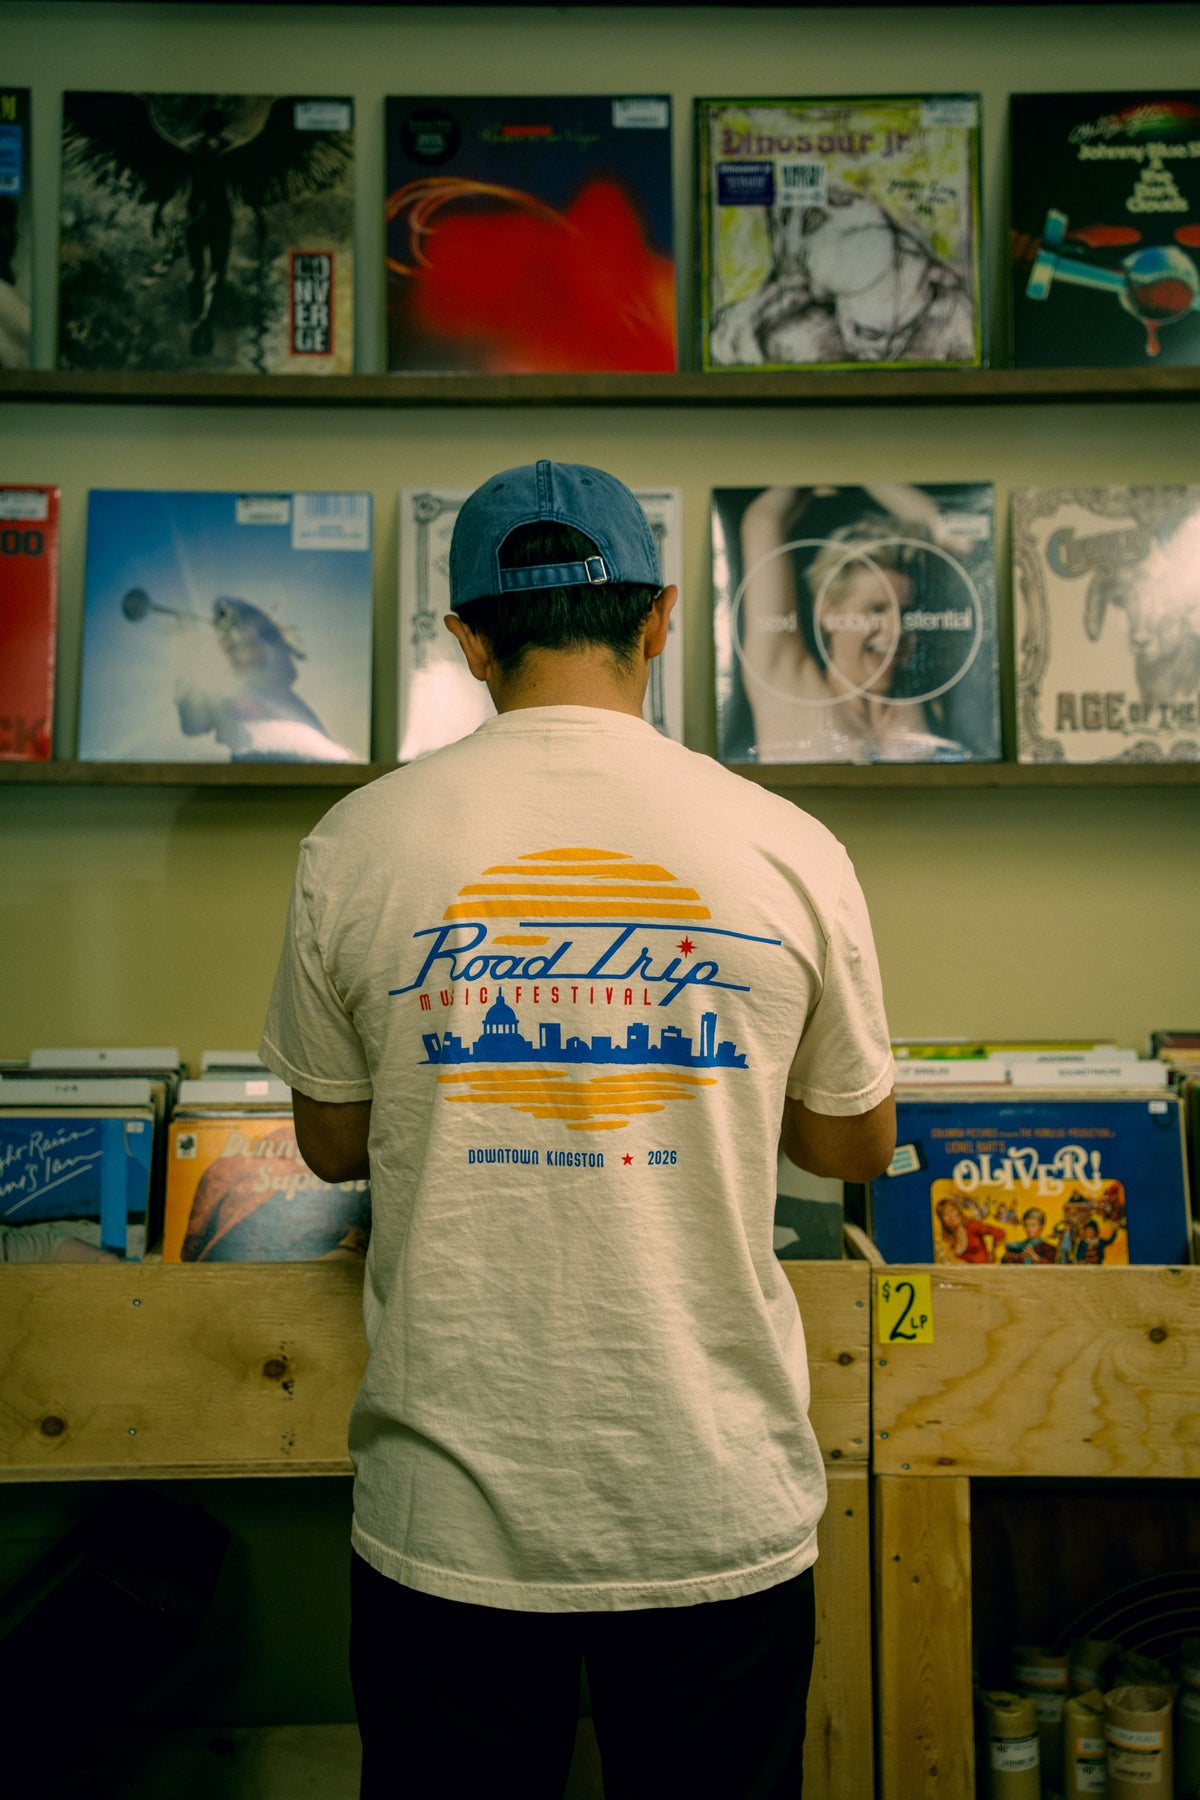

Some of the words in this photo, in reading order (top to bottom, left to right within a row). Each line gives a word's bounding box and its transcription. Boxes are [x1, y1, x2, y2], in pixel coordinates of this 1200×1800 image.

[1056, 692, 1125, 731] AGE
[389, 922, 573, 996] Road
[520, 922, 781, 1007] Trip
[515, 985, 652, 1006] FESTIVAL
[221, 1132, 308, 1167] Donn
[468, 1148, 539, 1165] DOWNTOWN
[546, 1150, 605, 1168] KINGSTON
[647, 1150, 678, 1166] 2026
[952, 1144, 1104, 1197] OLIVER!
[910, 1314, 928, 1329] LP
